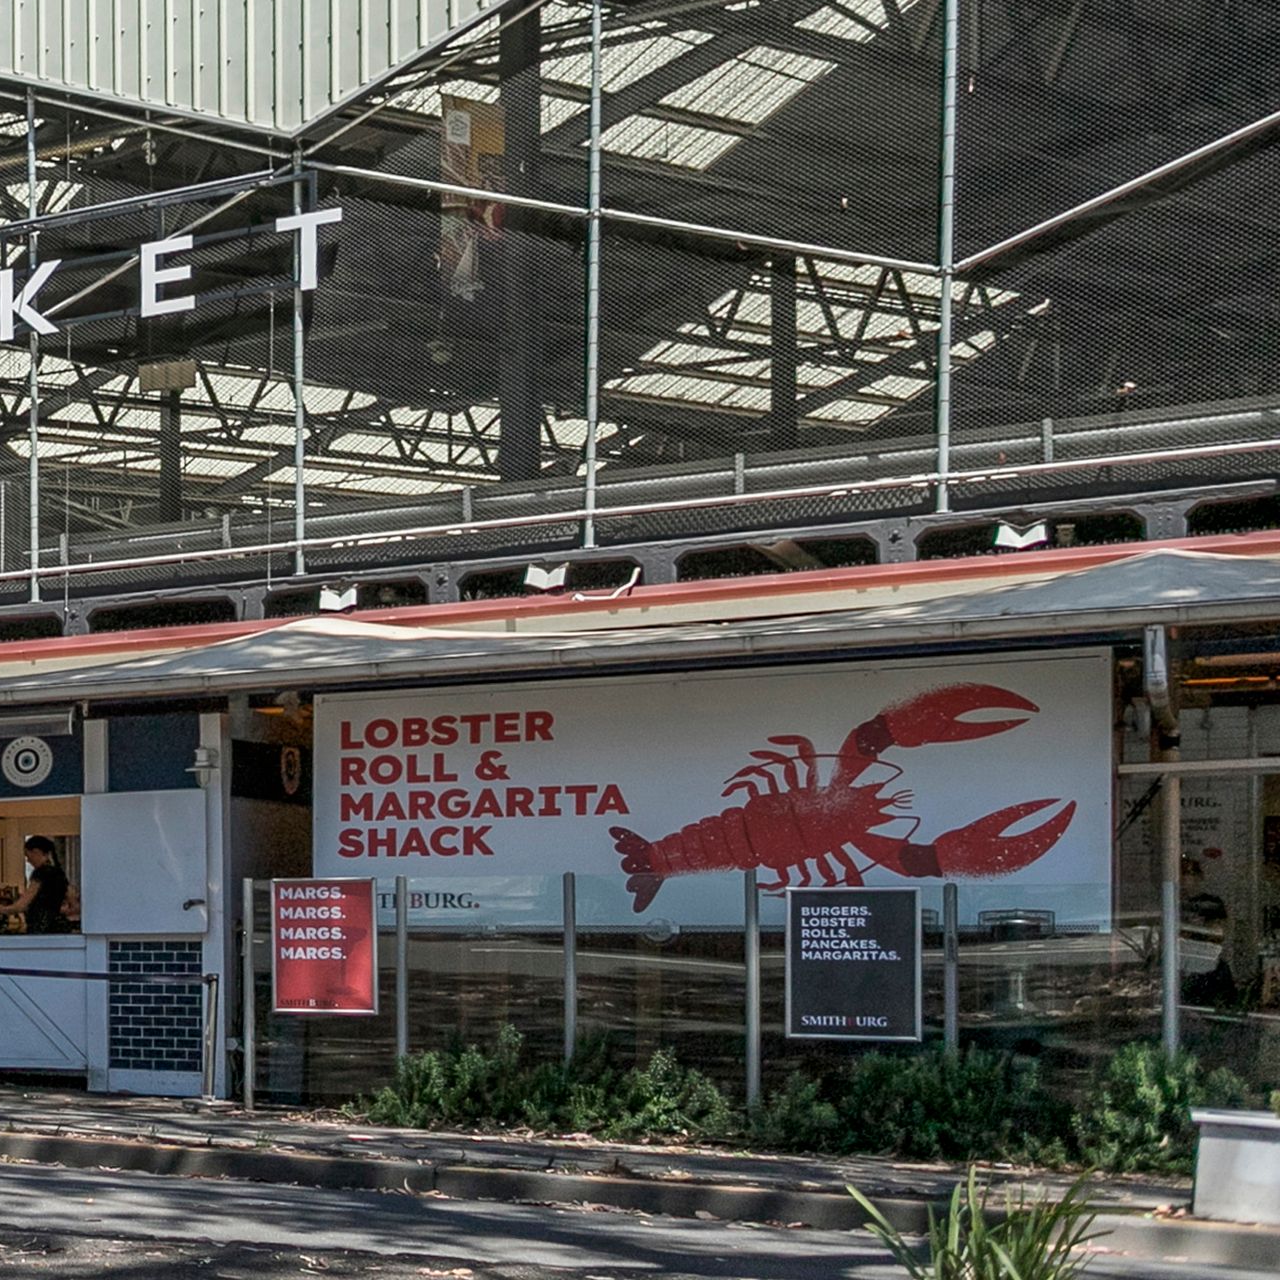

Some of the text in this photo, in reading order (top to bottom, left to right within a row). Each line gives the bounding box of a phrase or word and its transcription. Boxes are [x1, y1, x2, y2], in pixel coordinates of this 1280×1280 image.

[341, 710, 554, 750] LOBSTER
[341, 750, 511, 786] ROLL &
[340, 784, 630, 821] MARGARITA
[338, 825, 494, 858] SHACK
[279, 886, 346, 899] MARGS.
[280, 906, 346, 919] MARGS.
[801, 906, 872, 916] BURGERS.
[801, 917, 865, 927] LOBSTER
[280, 927, 347, 940] MARGS.
[801, 928, 850, 938] ROLLS.
[801, 939, 881, 949] PANCAKES.
[280, 947, 347, 960] MARGS.
[801, 951, 901, 960] MARGARITAS.
